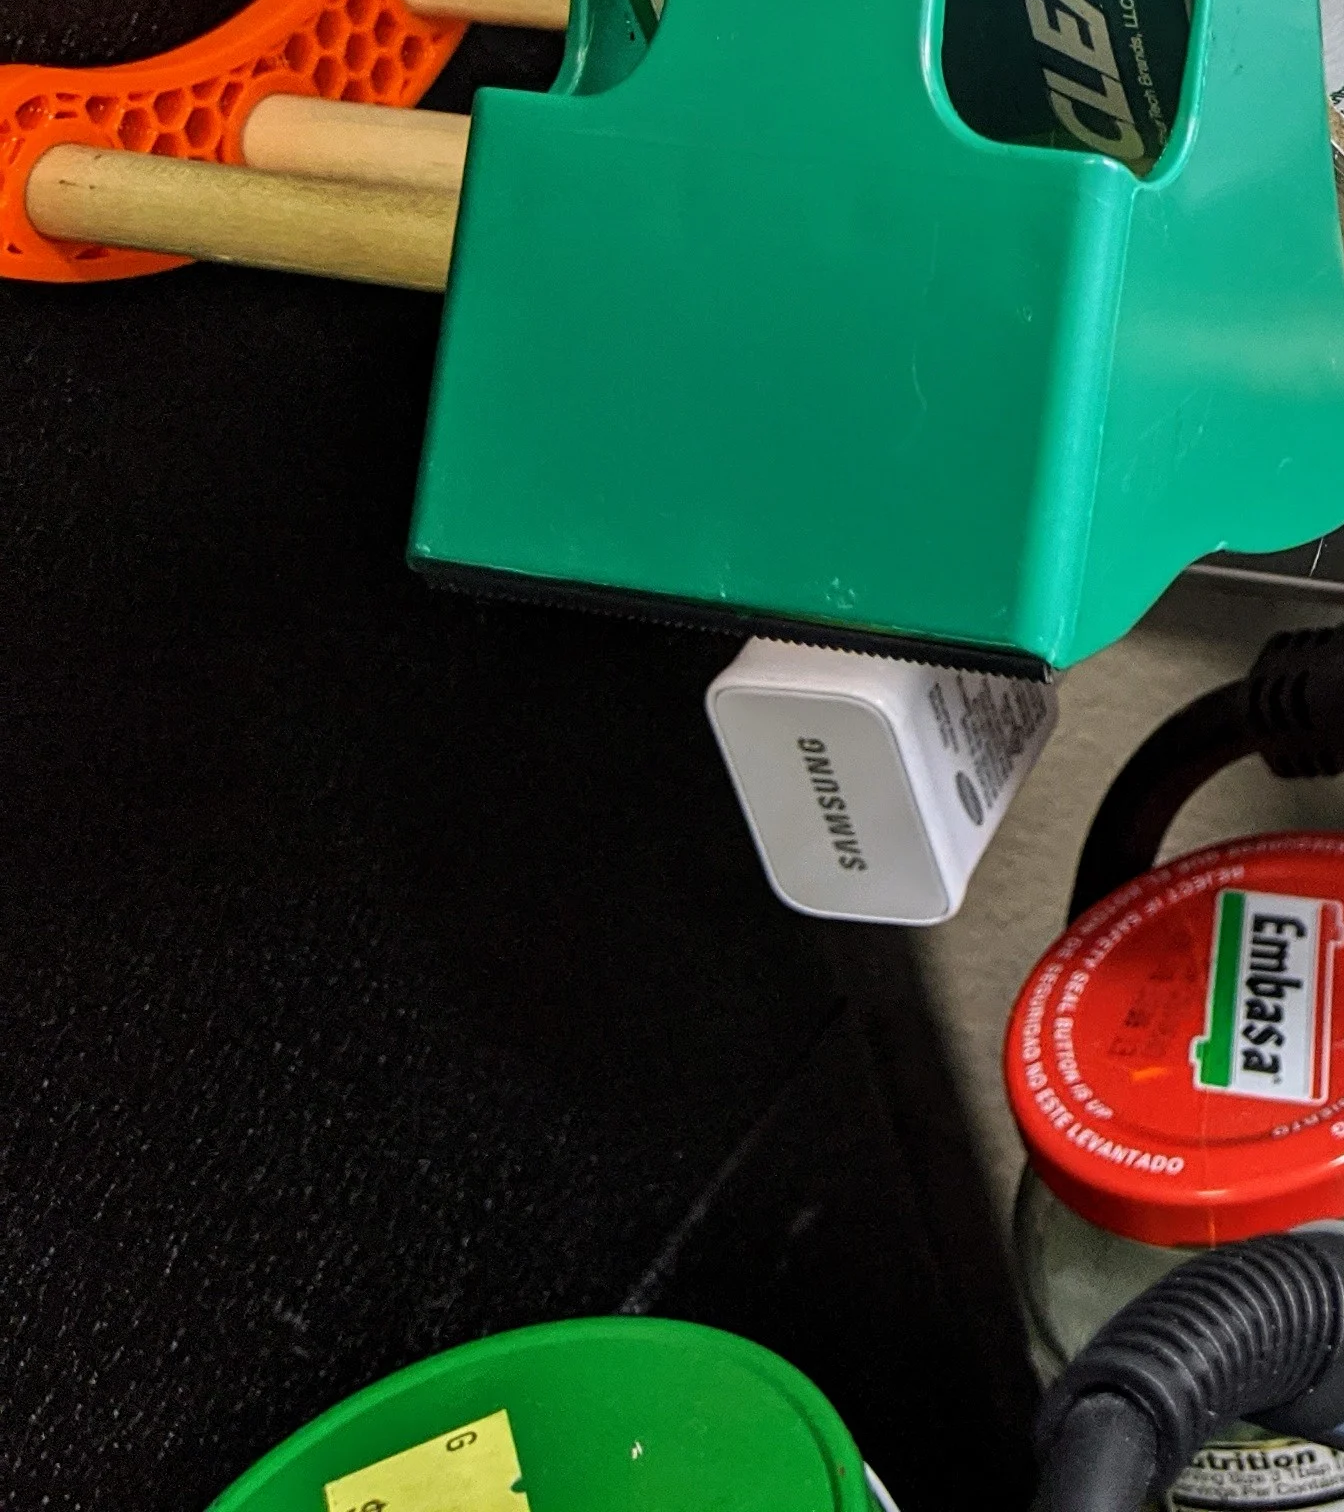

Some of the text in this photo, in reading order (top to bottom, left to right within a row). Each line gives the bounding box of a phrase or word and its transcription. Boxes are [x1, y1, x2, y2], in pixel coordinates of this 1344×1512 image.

[1130, 32, 1152, 87] Brands,
[798, 737, 868, 872] SAMSUNG
[1055, 969, 1090, 1016] SEAL
[1242, 914, 1307, 1074] Embasa
[1053, 1016, 1081, 1085] BUTTON
[1024, 1060, 1048, 1091] NO
[1070, 1082, 1094, 1102] IS
[1035, 1086, 1075, 1130] ESTE
[1084, 1099, 1114, 1120] UP
[1066, 1122, 1185, 1176] LEVANTADO
[446, 1431, 477, 1452] G
[1193, 1450, 1317, 1471] trition
